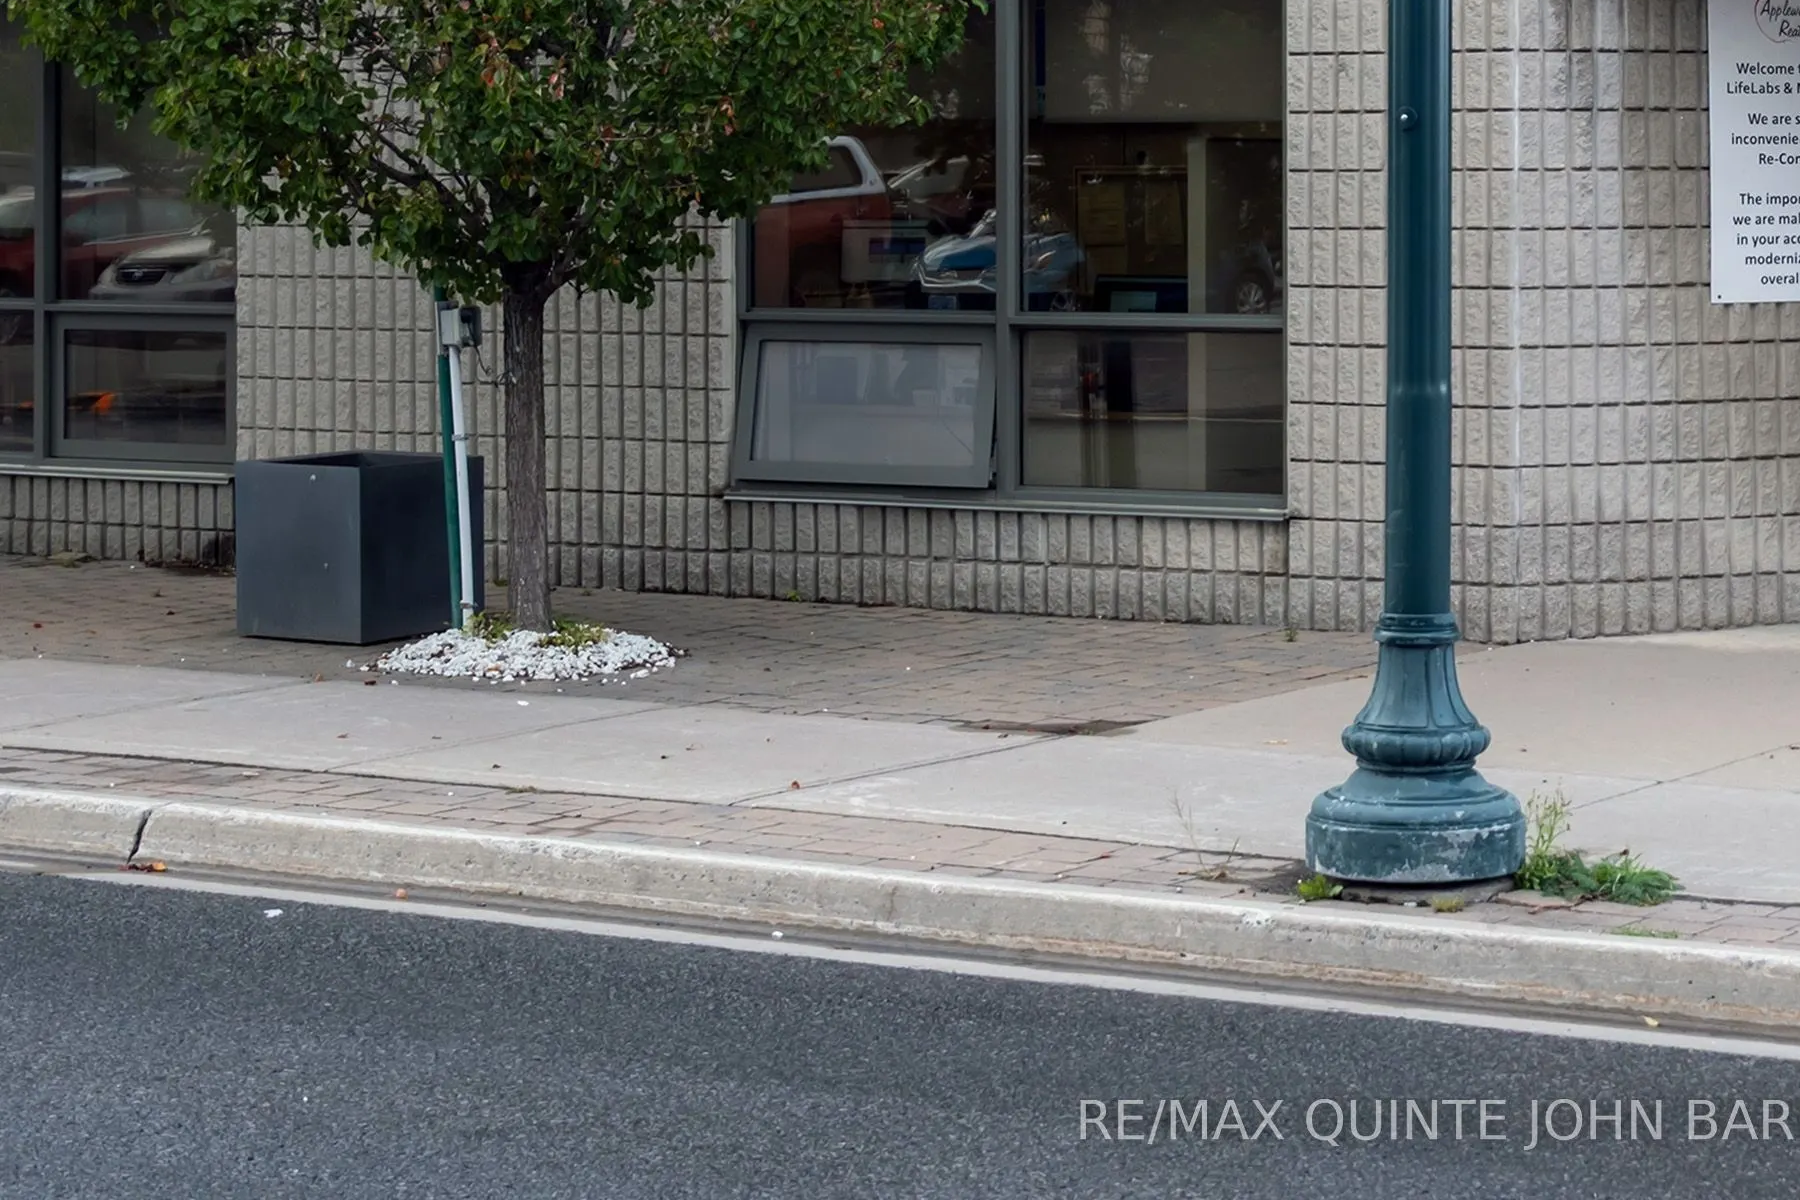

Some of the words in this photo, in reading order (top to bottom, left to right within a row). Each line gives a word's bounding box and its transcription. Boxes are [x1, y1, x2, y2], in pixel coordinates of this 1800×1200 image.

[1736, 62, 1795, 75] Welcome
[1726, 82, 1780, 94] LifeLabs
[1783, 82, 1793, 94] &
[1747, 113, 1768, 125] We
[1772, 115, 1792, 125] are
[1740, 193, 1762, 205] The
[1733, 215, 1751, 225] we
[1755, 215, 1775, 225] are
[1737, 233, 1748, 245] in
[1752, 235, 1780, 247] your
